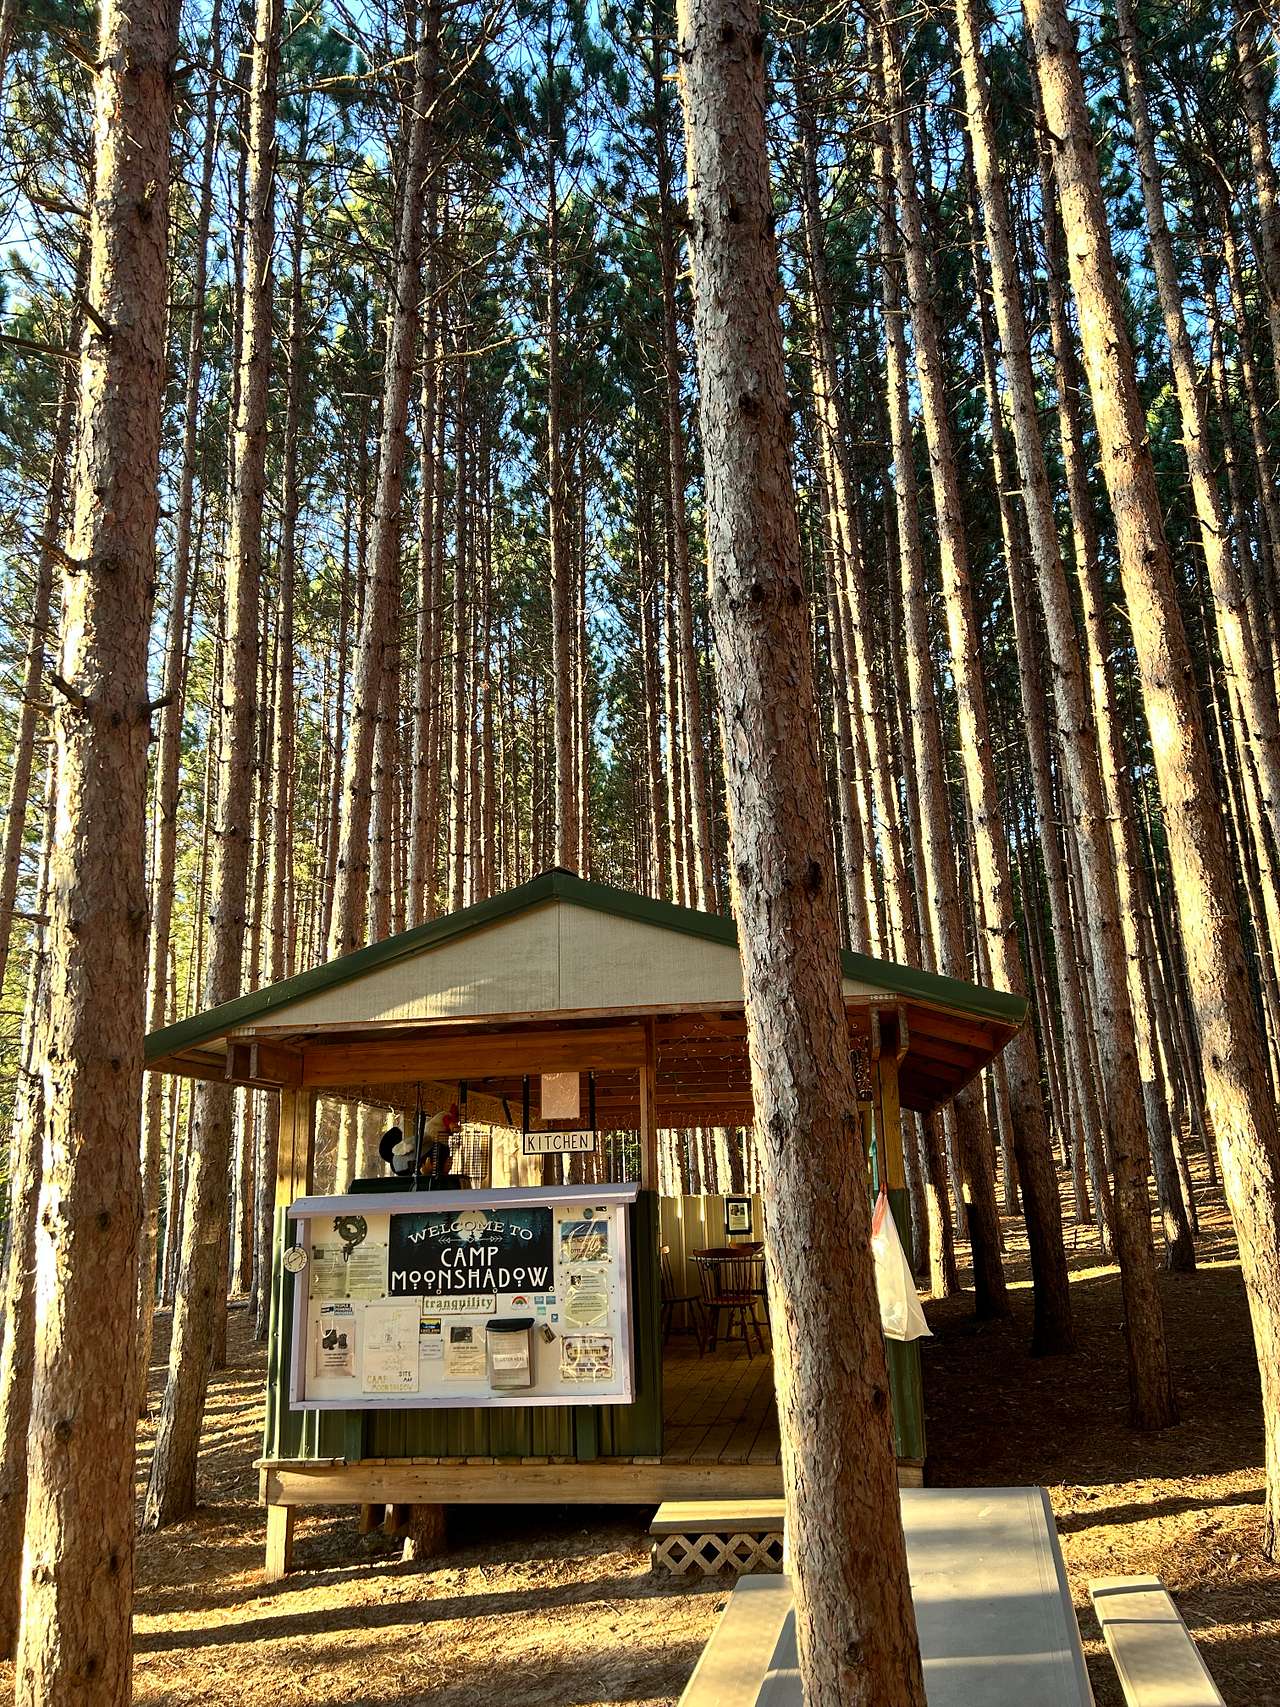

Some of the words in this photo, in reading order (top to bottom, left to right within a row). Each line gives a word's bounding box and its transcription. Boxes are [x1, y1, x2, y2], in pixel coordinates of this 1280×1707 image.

[528, 1134, 588, 1151] KITCHEN
[408, 1221, 505, 1244] WELCOME
[509, 1224, 533, 1241] TO
[441, 1246, 499, 1268] CAMP
[391, 1266, 549, 1291] MOONSHADOW
[425, 1297, 494, 1311] tranquility
